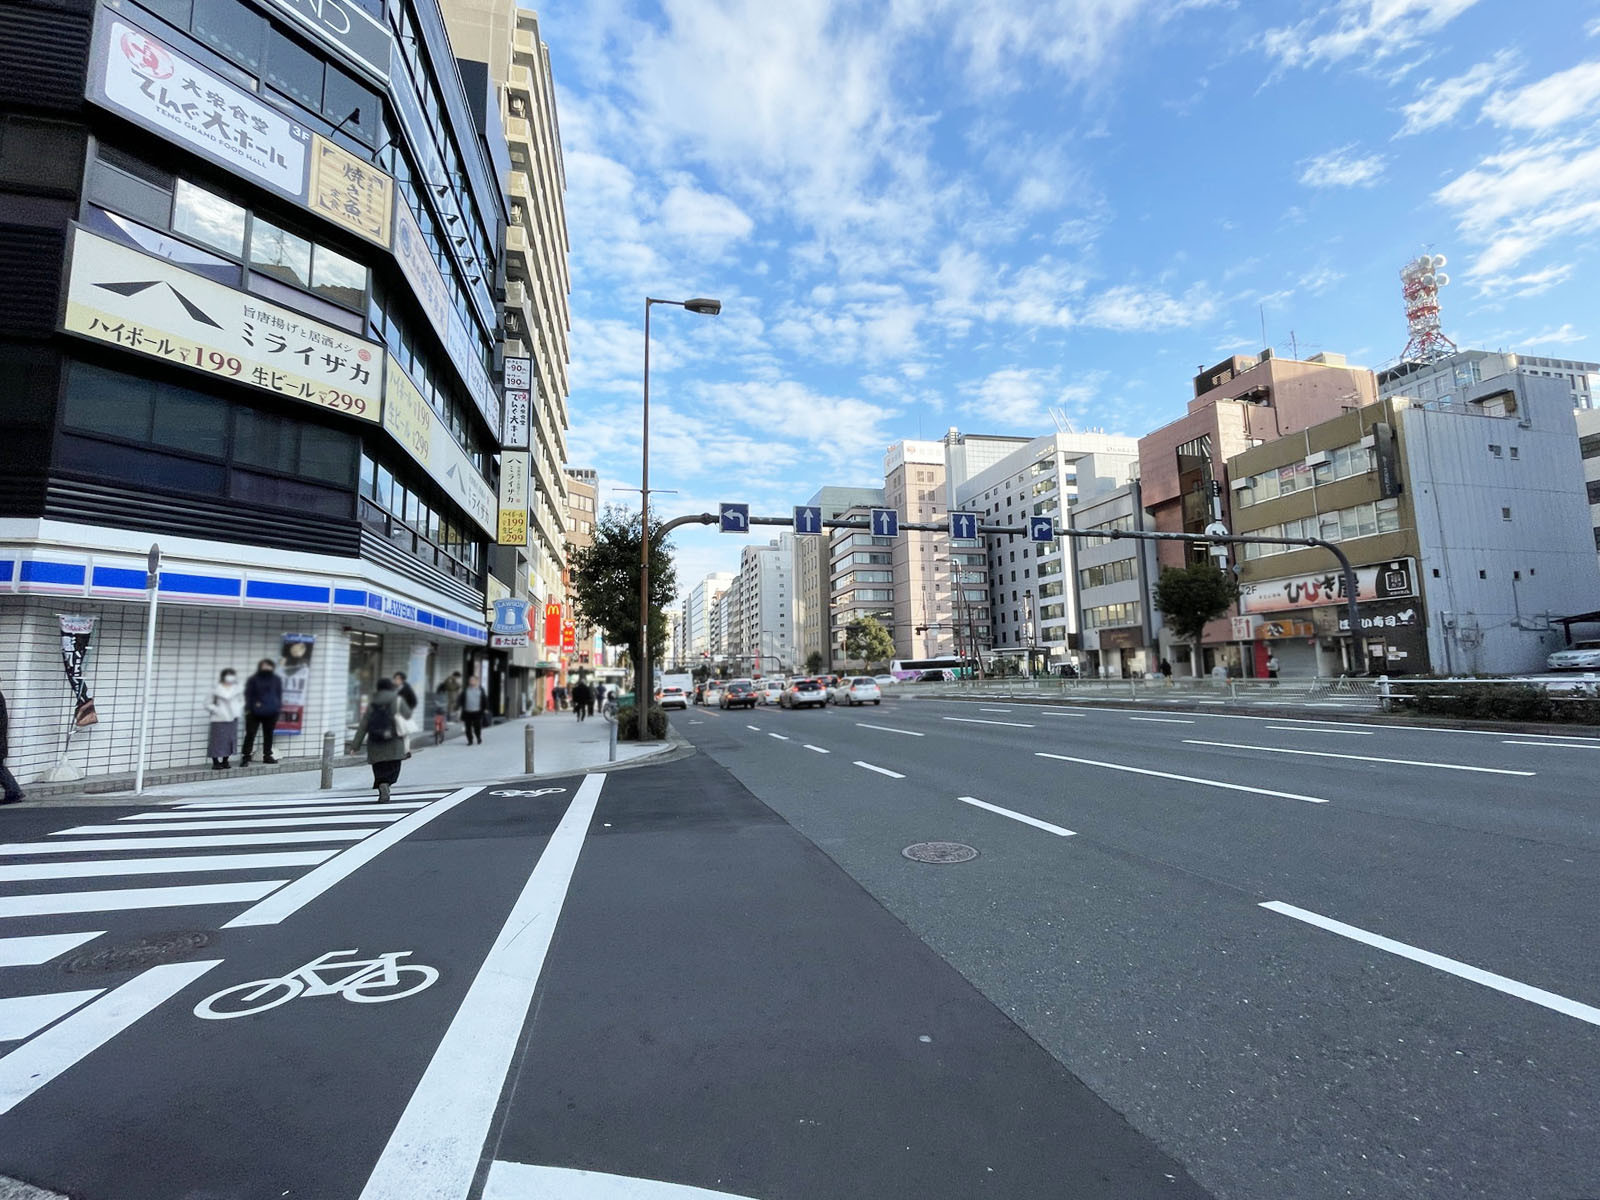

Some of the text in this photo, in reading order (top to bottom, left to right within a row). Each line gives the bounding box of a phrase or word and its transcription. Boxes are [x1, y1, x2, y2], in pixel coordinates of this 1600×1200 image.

[131, 67, 289, 170] てんぐ大ホール
[181, 76, 271, 136] 大衆食堂
[291, 125, 311, 142] 3F
[155, 106, 268, 169] TENG GRAND FOOD HALL
[342, 161, 366, 226] 焼き魚
[241, 321, 371, 386] ミライザカ
[243, 304, 354, 353] 旨唐揚げと居酒メシ
[88, 317, 176, 356] ハイボール
[250, 366, 317, 399] 生ビール
[509, 393, 519, 444] てんぐ大ホール
[383, 597, 416, 622] LAWSON
[1245, 585, 1257, 596] 2F
[1283, 573, 1361, 605] ひびき屋
